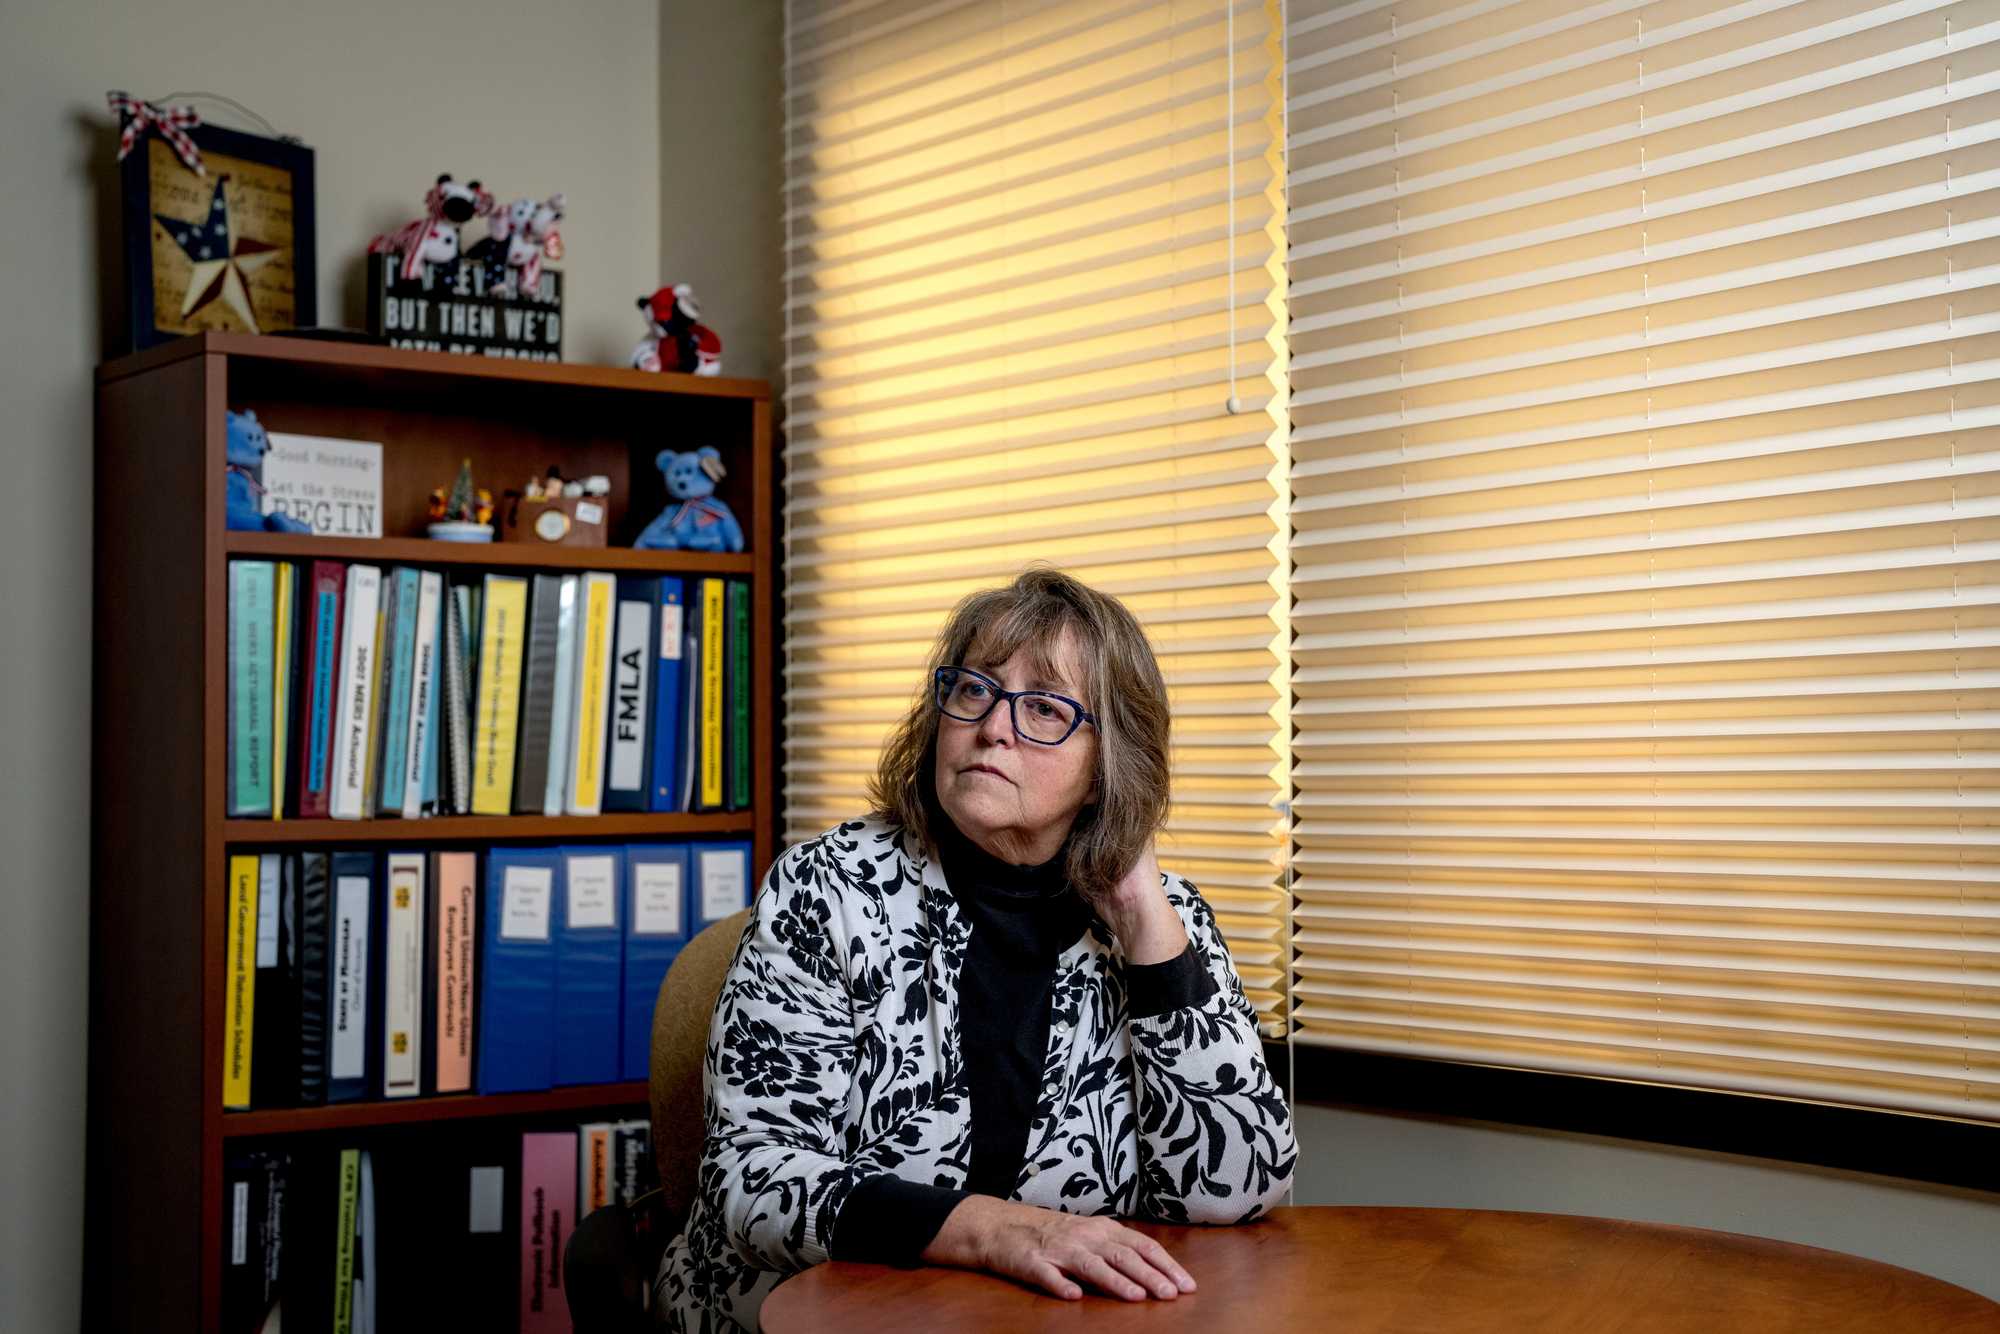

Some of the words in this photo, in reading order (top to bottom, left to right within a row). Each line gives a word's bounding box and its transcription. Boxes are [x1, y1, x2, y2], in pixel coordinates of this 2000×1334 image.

[386, 297, 429, 332] BUT
[439, 302, 496, 338] THEN
[504, 307, 561, 344] WE'D
[352, 684, 366, 721] MERS
[618, 648, 642, 742] FMLA
[249, 735, 260, 788] REPORT
[348, 724, 362, 788] Actuarial
[239, 874, 249, 903] Local
[460, 885, 472, 937] Current
[237, 906, 248, 972] Government
[445, 905, 457, 971] Employee
[235, 975, 246, 1026] Retention
[446, 975, 457, 1038] Contracts
